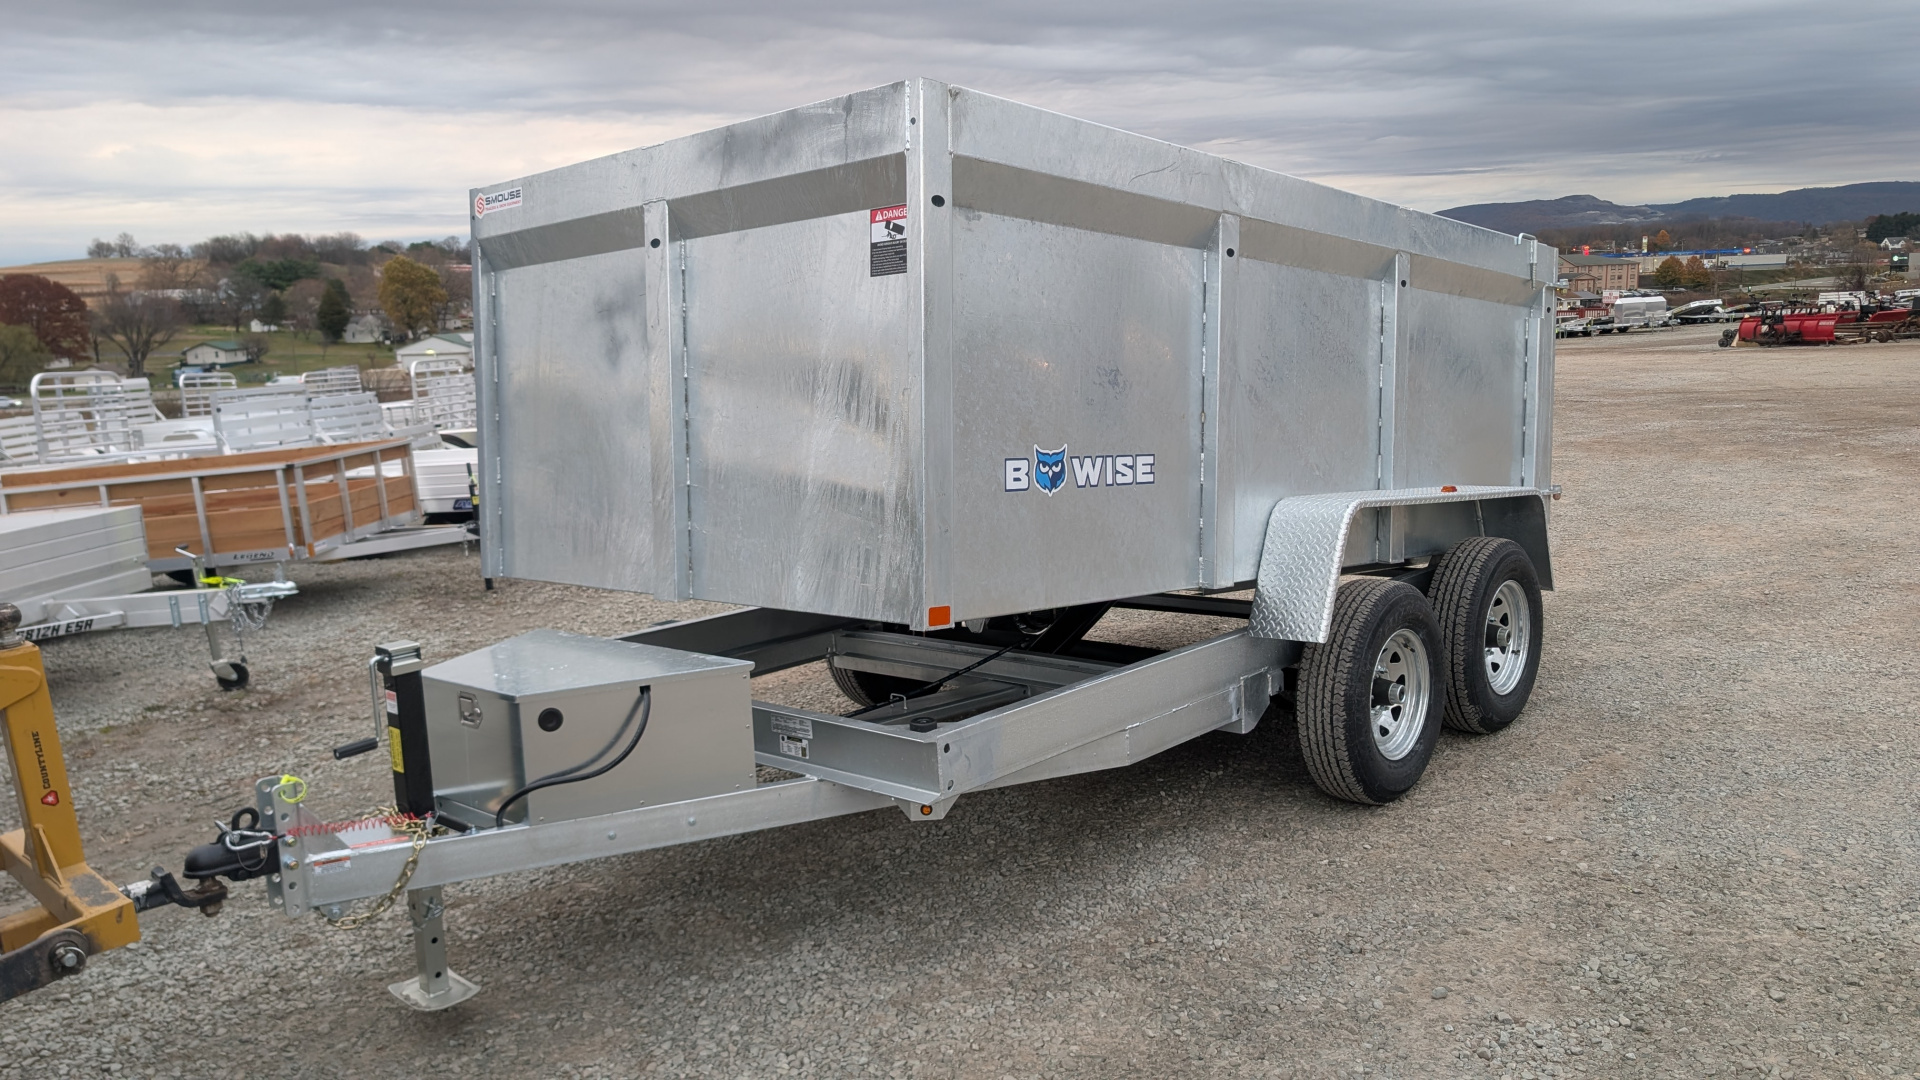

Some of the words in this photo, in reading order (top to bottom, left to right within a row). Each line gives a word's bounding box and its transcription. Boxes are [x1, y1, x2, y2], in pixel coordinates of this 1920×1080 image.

[485, 189, 521, 206] SMOUSE
[883, 208, 907, 220] DANGE
[32, 730, 51, 790] COUNTYLINE
